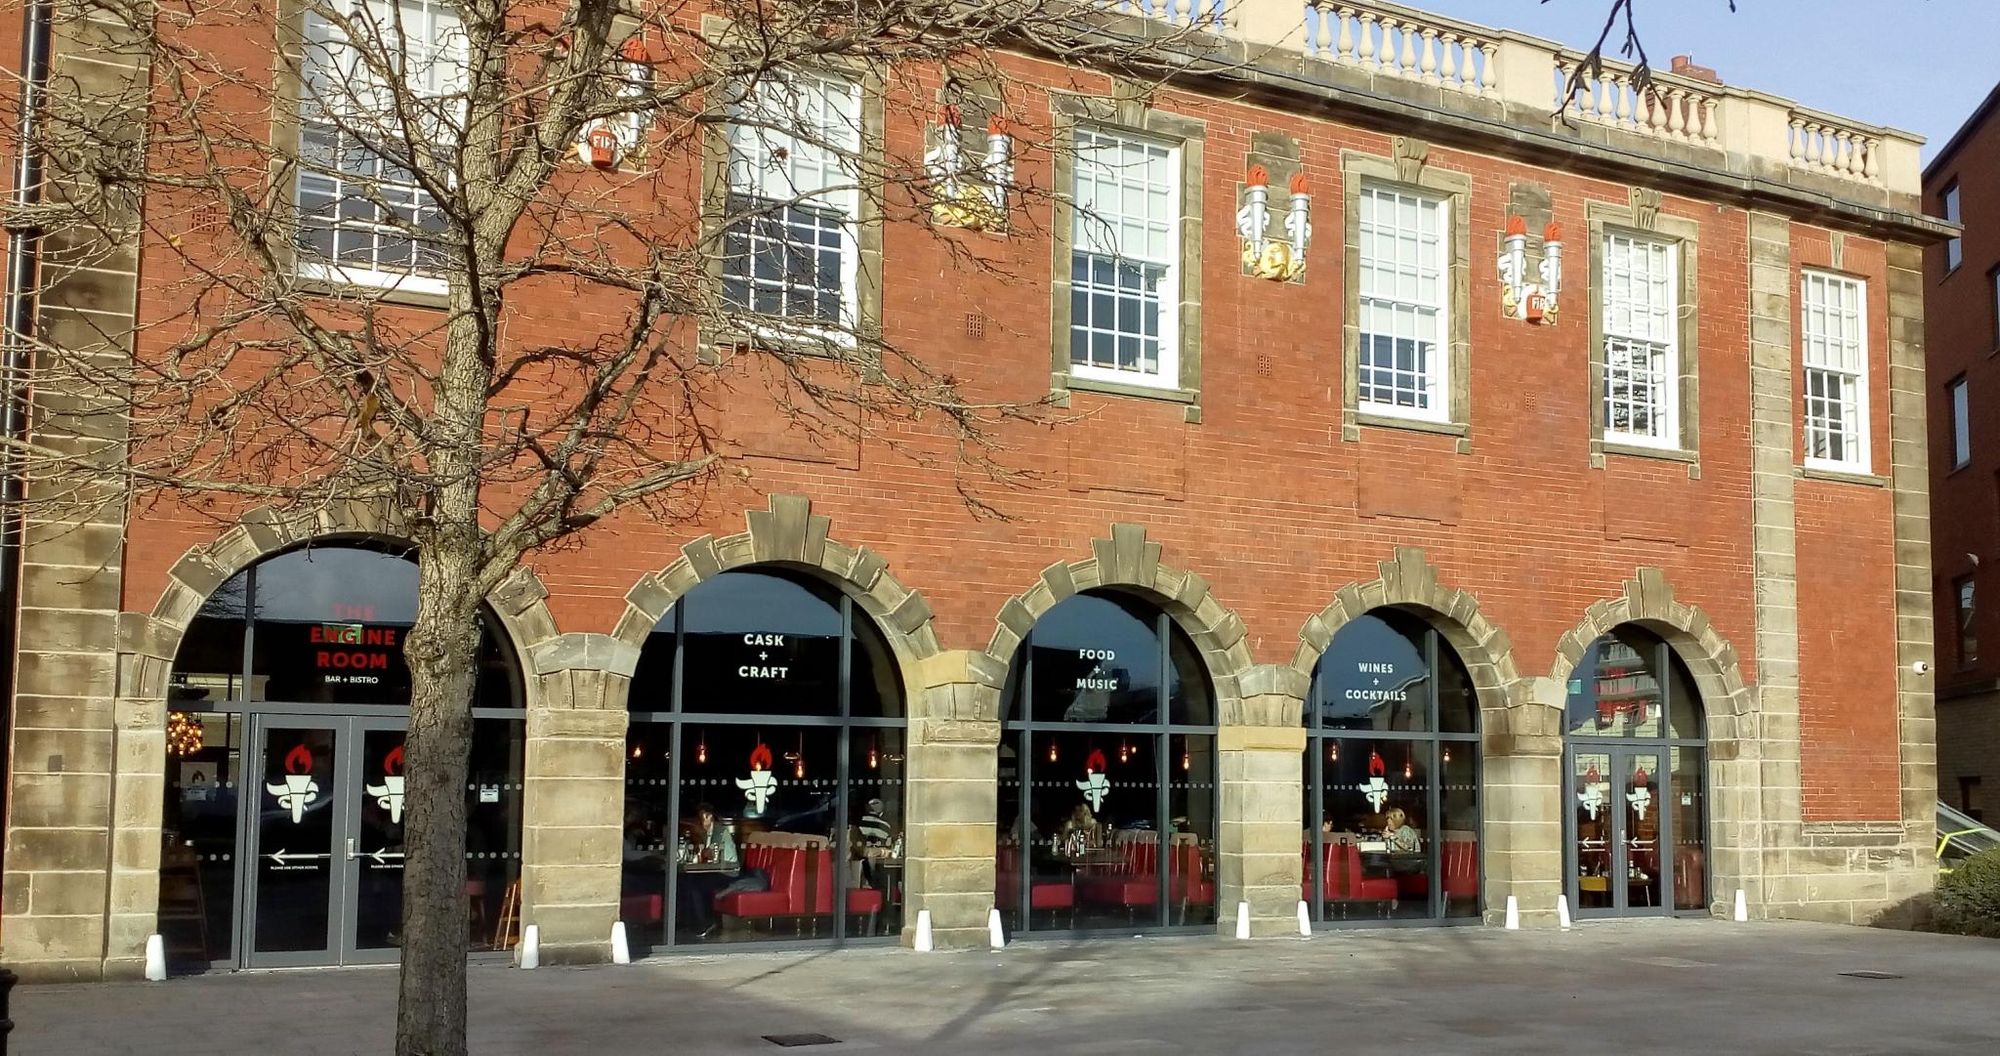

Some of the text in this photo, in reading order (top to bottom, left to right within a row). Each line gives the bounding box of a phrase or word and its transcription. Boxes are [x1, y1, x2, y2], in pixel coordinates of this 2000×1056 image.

[334, 603, 375, 619] THE
[310, 626, 396, 646] ENGINE
[743, 633, 784, 647] CASK
[316, 651, 388, 669] ROOM
[759, 651, 768, 661] +
[1079, 648, 1115, 661] FOOD
[738, 665, 789, 679] CRAFT
[1093, 665, 1101, 674] +
[1358, 662, 1394, 674] WINES
[324, 675, 341, 683] BAR
[349, 676, 379, 684] BISTRO
[1076, 678, 1118, 690] MUSIC
[1372, 677, 1380, 686] +
[1345, 689, 1407, 701] COCKTAILS
